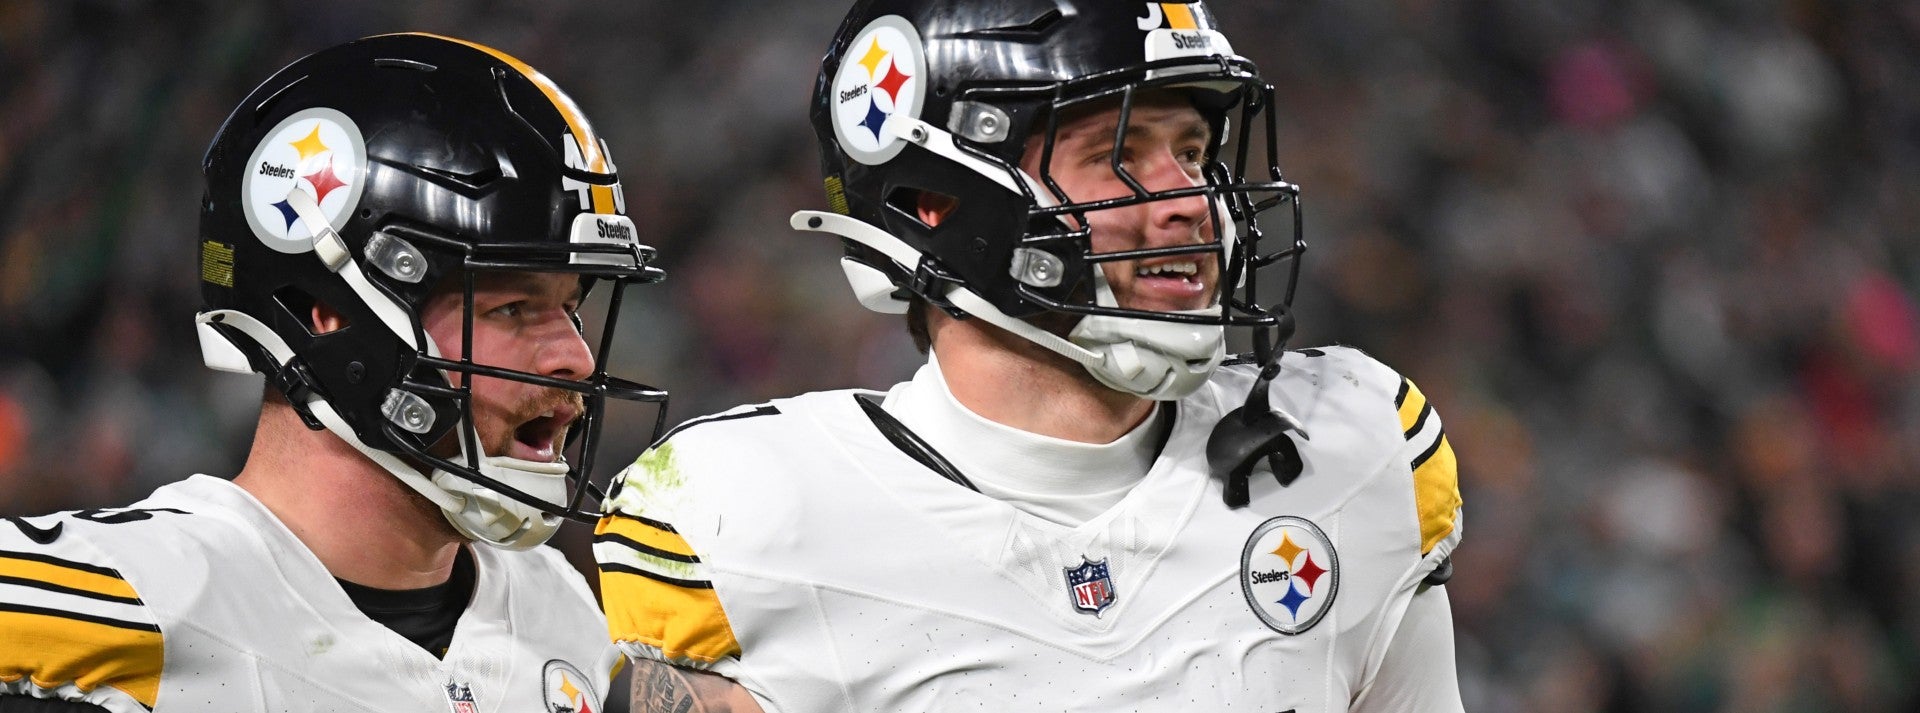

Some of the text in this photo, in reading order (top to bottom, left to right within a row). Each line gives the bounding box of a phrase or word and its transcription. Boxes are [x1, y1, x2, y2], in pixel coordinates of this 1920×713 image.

[840, 84, 868, 104] Steelers
[259, 161, 296, 179] Steelers
[1251, 569, 1290, 584] Steelers
[1075, 581, 1111, 606] NFL
